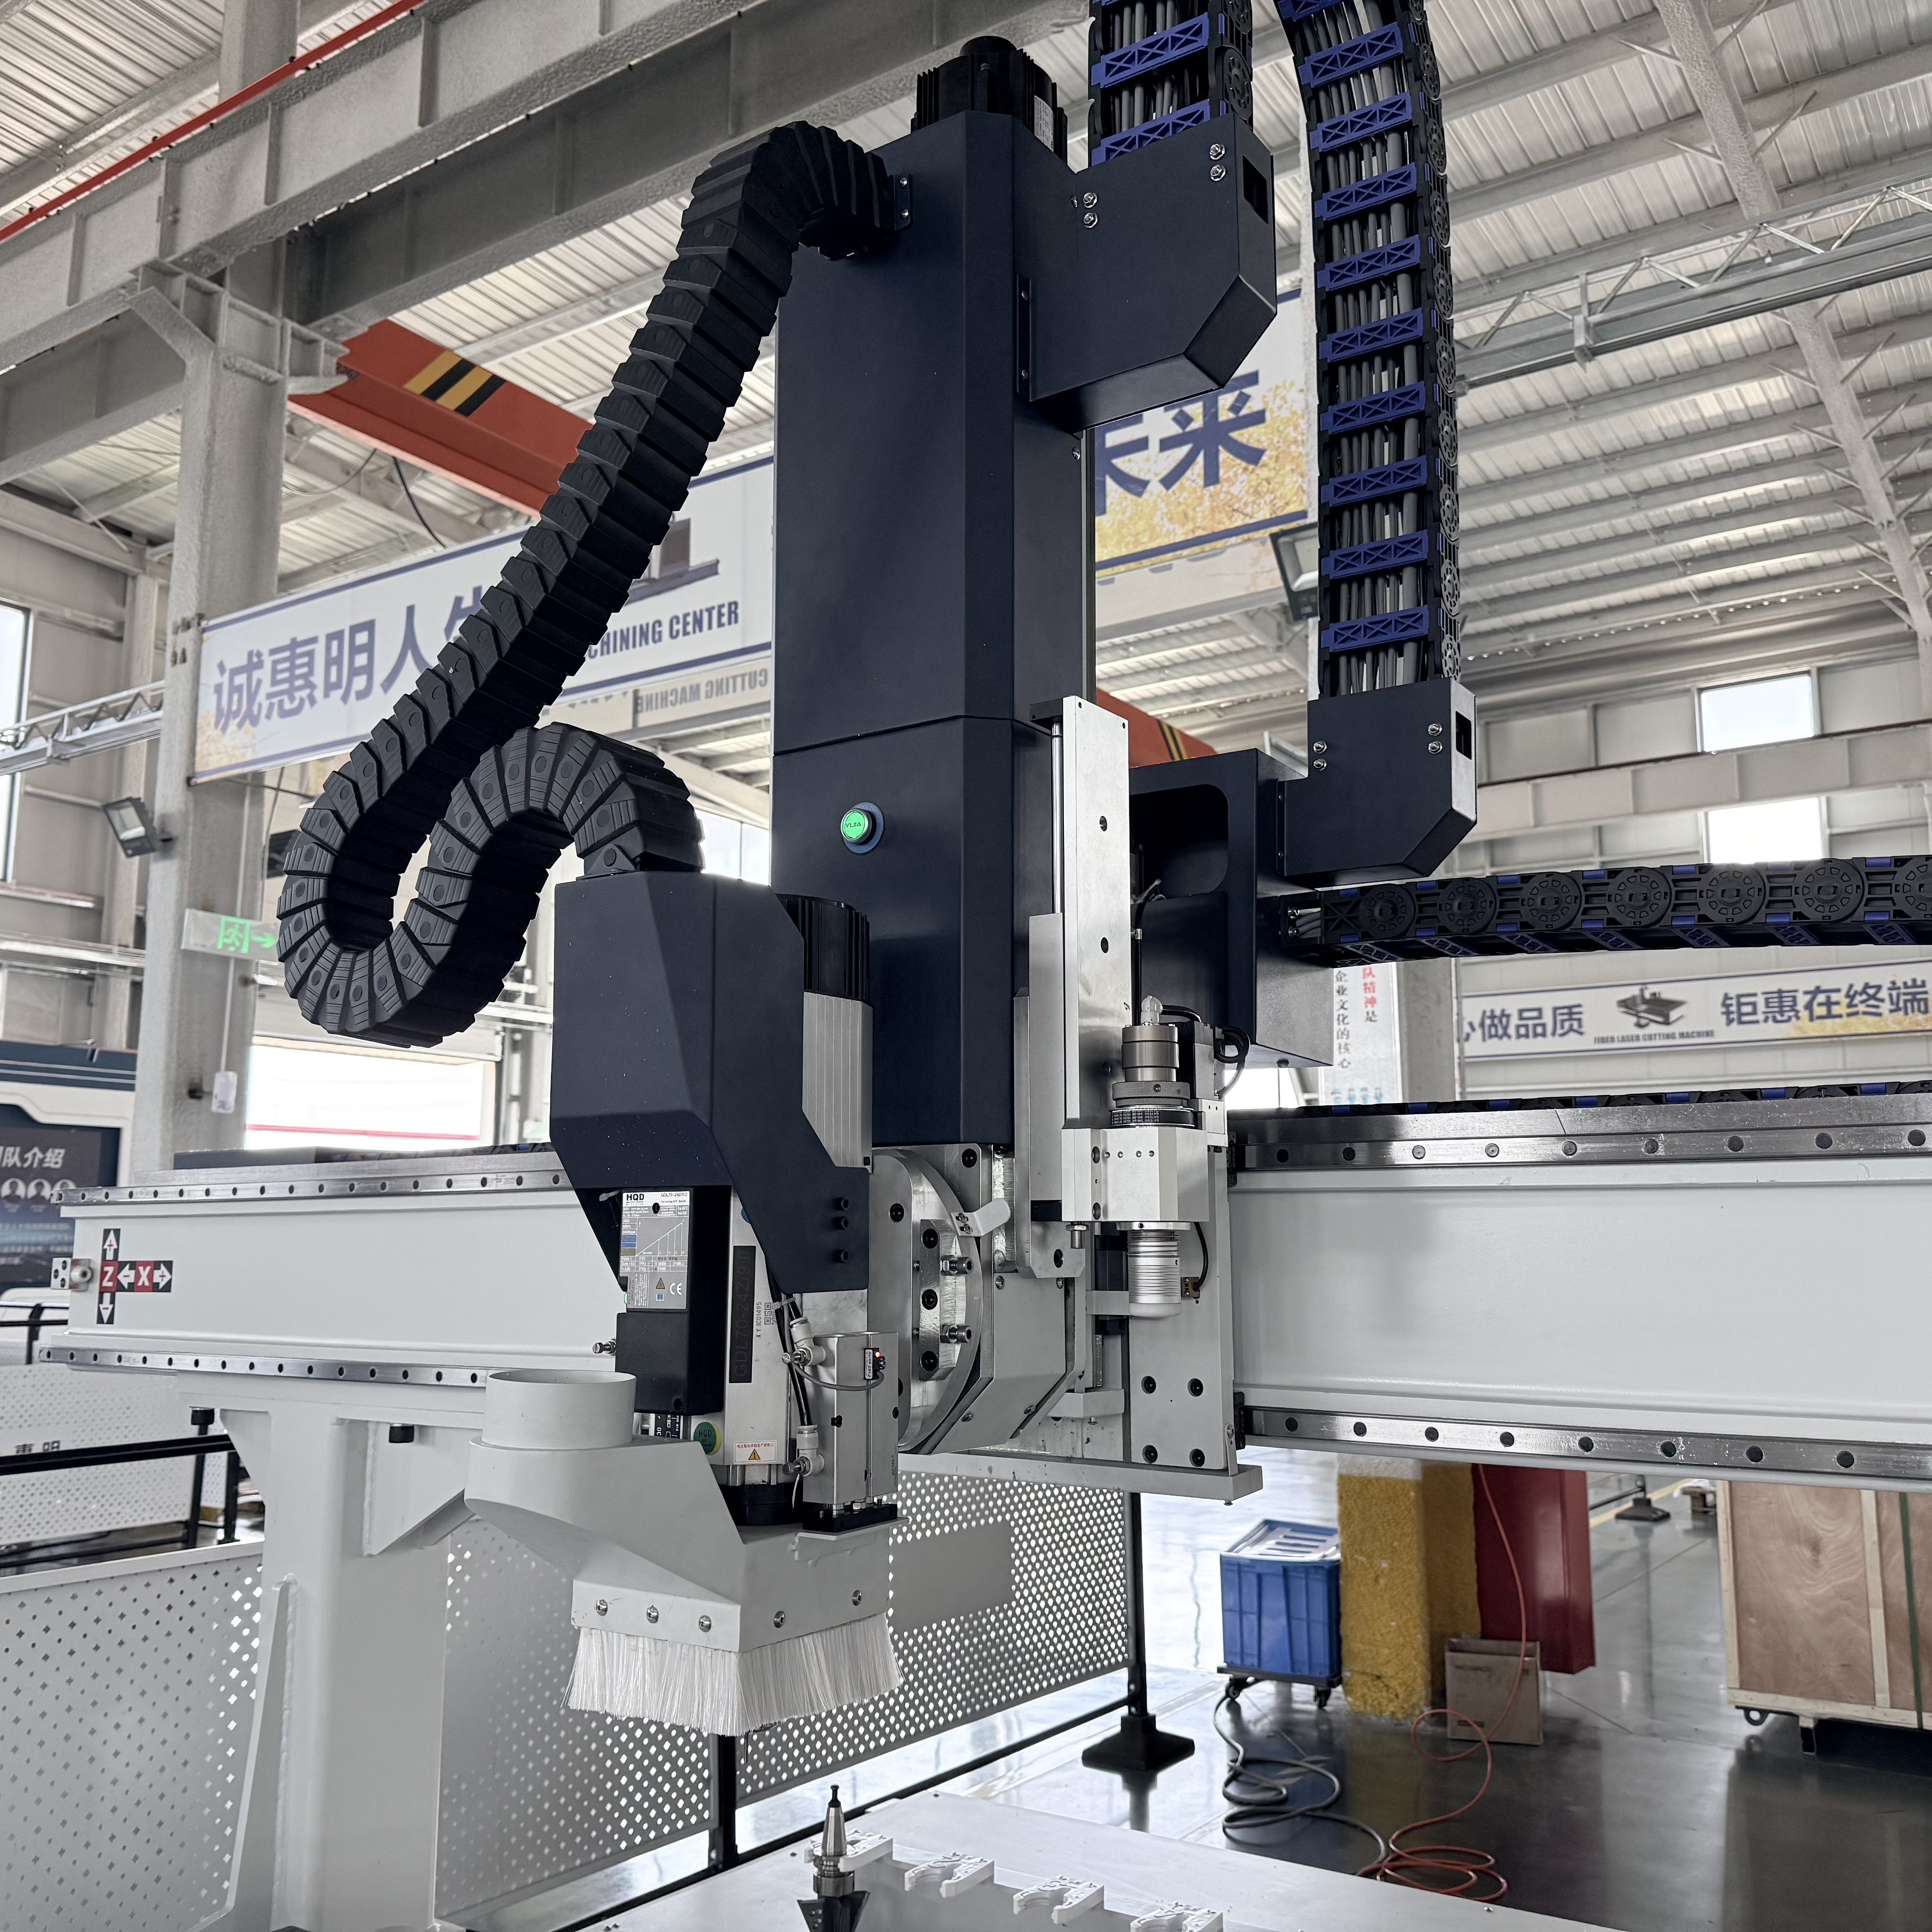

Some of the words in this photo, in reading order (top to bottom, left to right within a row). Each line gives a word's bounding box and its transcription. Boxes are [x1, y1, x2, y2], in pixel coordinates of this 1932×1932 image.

[669, 601, 739, 639] CENTER
[1335, 971, 1351, 1069] 企业文化的核心
[1721, 977, 1929, 1026] 钜惠在终端
[0, 1145, 65, 1169] 队介绍
[102, 1267, 114, 1287] Z
[137, 1266, 151, 1286] X
